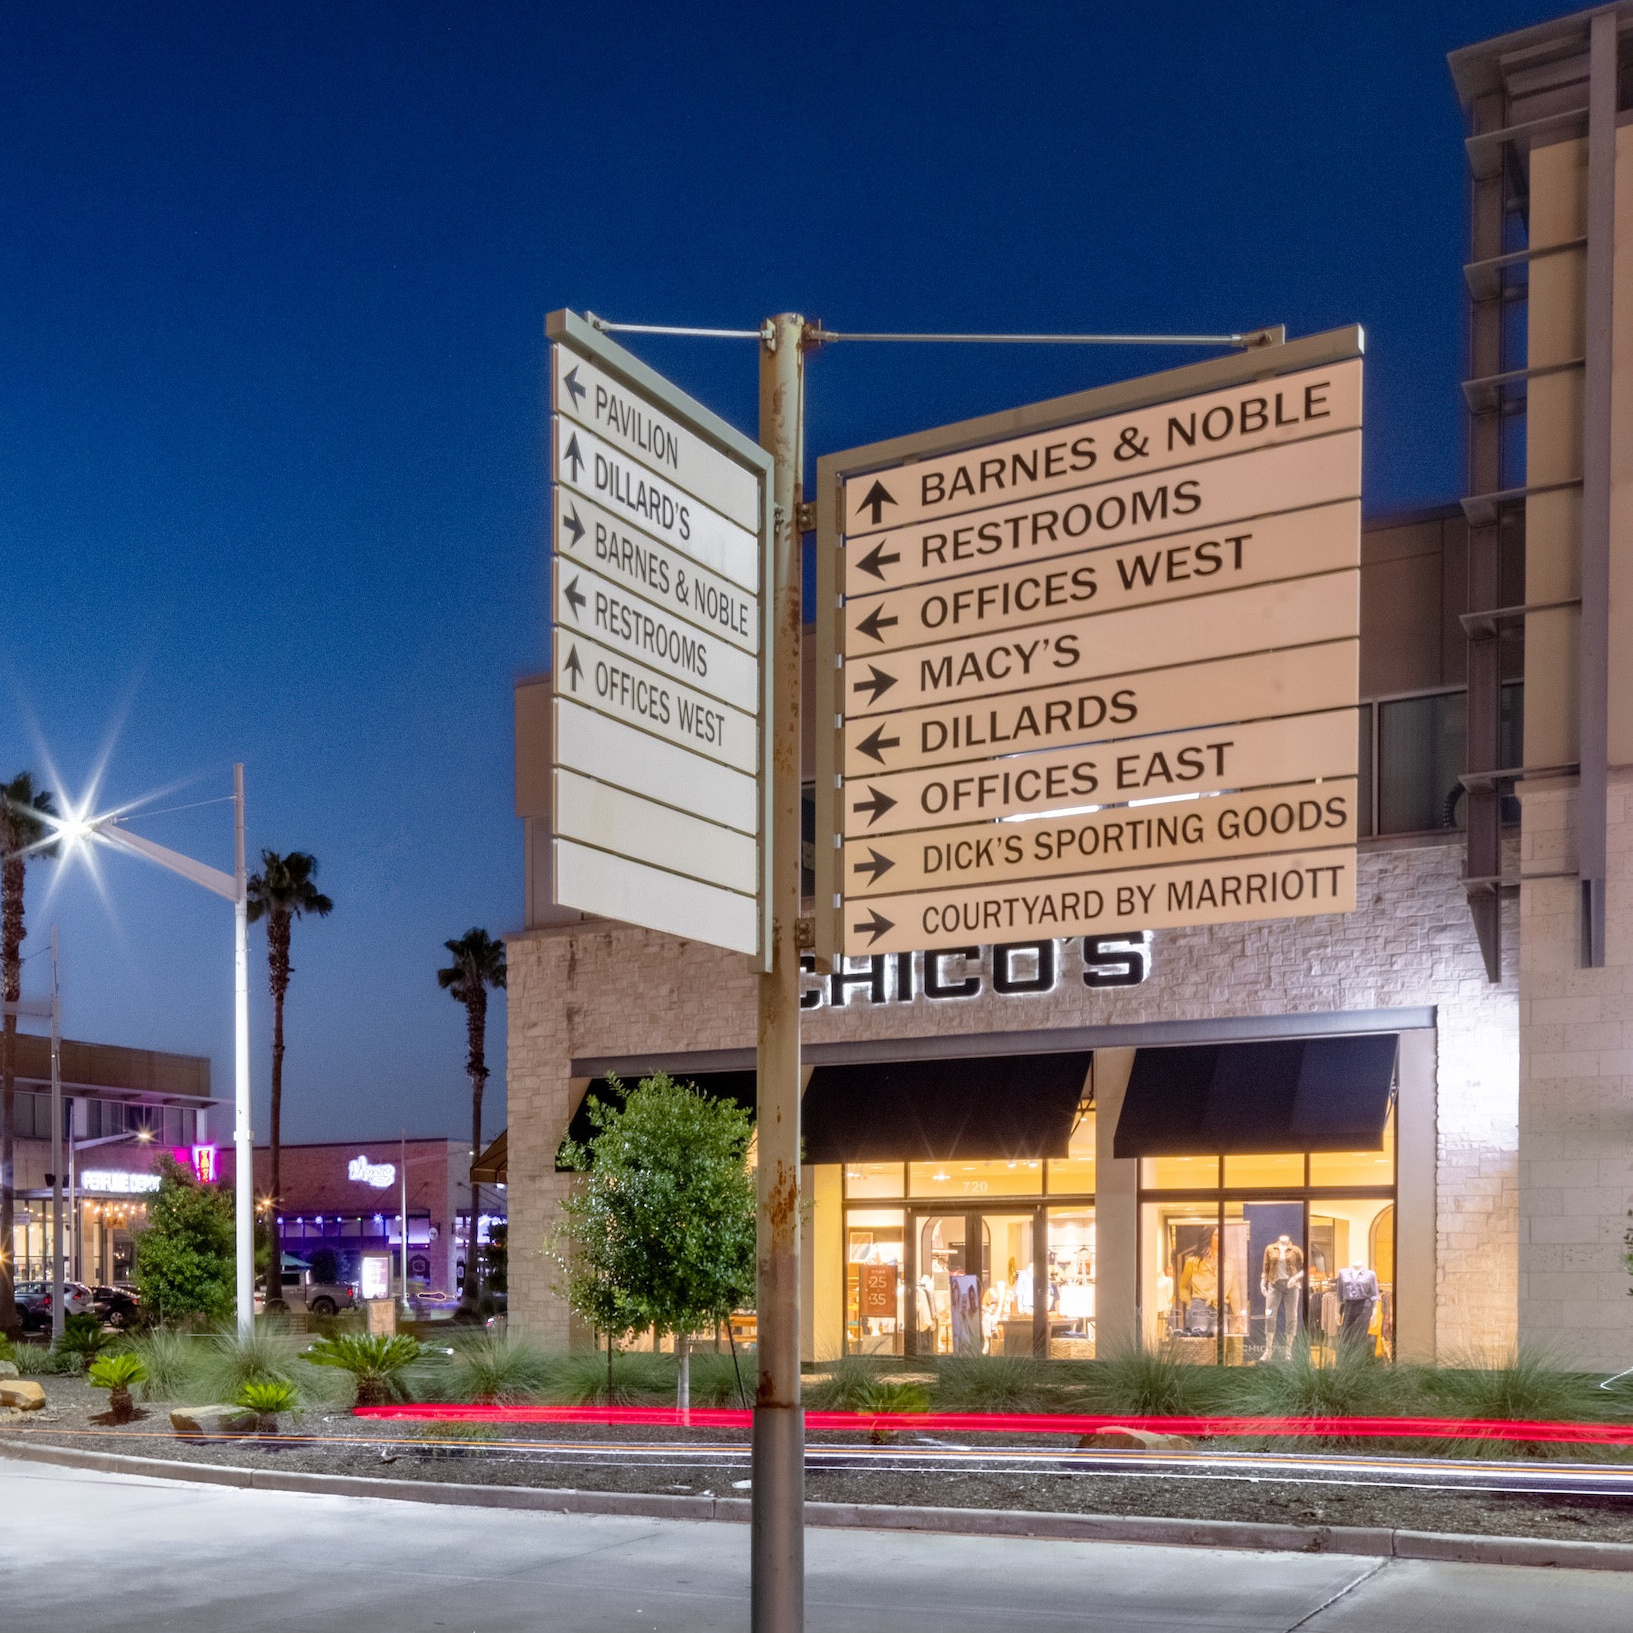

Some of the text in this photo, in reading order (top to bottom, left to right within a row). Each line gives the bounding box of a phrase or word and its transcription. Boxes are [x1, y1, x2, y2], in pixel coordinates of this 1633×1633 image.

[596, 384, 678, 470] PAVILION
[920, 381, 1331, 507] BARNES & NOBLE
[595, 452, 691, 541] DILLARD'S
[920, 480, 1203, 568] RESTROOMS
[596, 522, 749, 637] BARNES & NOBLE
[920, 534, 1254, 629] OFFICES WEST
[596, 591, 708, 677] RESTROOMS
[920, 633, 1081, 692] MACY'S
[595, 661, 725, 746] OFFICES WEST
[920, 690, 1138, 754] DILLARDS
[920, 741, 1234, 814] OFFICES EAST
[923, 797, 1348, 874] DICK'S SPORTING GOODS
[922, 865, 1345, 935] COURTYARD BY MARRIOTT
[963, 1181, 988, 1192] 720
